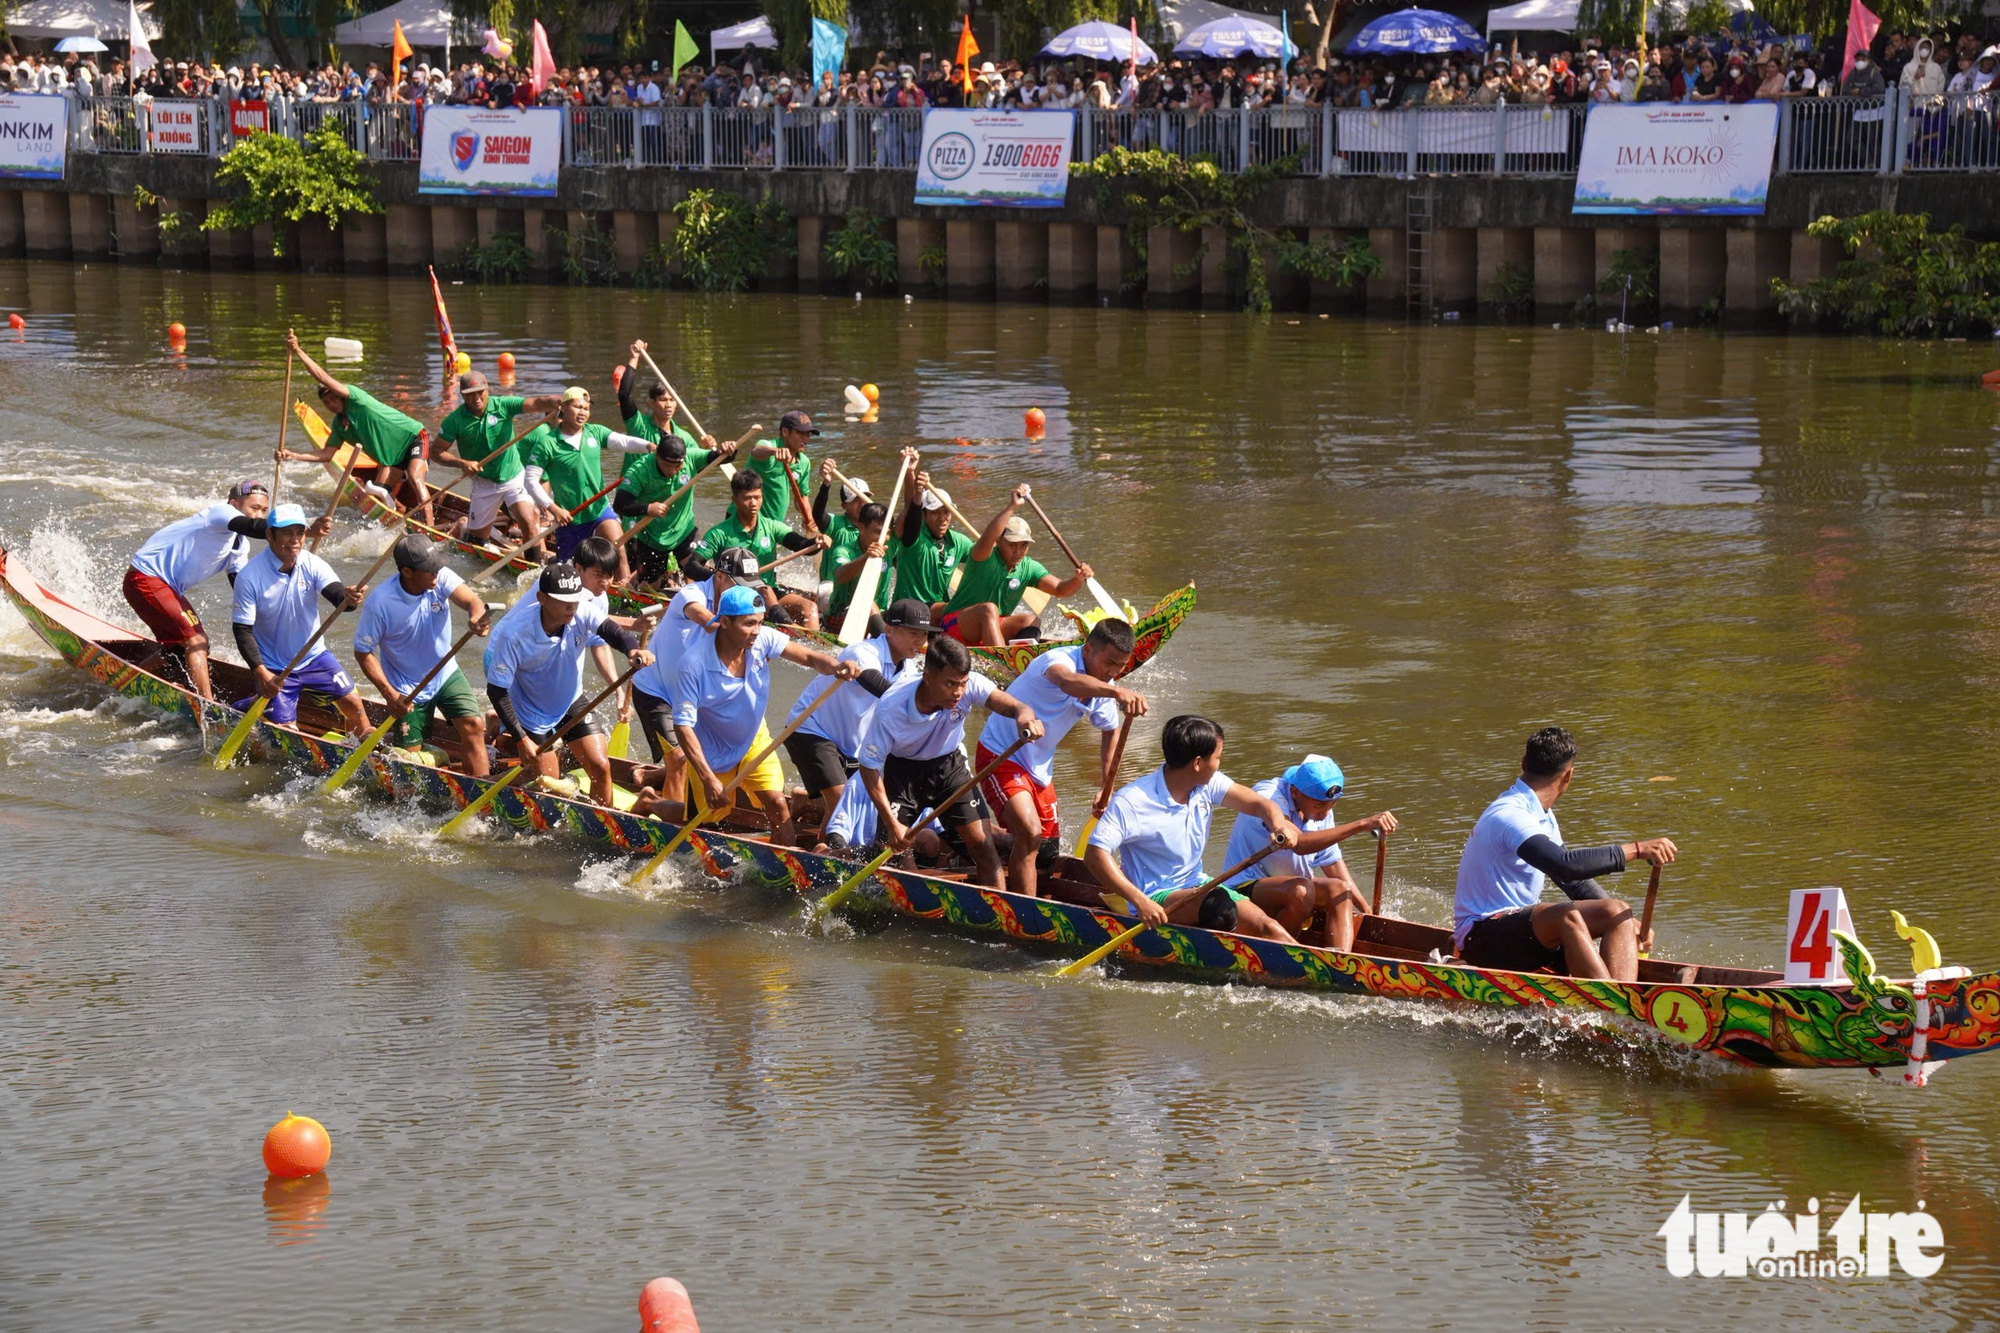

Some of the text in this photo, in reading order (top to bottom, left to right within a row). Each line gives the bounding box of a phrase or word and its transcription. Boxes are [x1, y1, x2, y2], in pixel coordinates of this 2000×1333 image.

[157, 108, 193, 125] LỐI LÊN
[234, 110, 264, 128] 400M
[0, 121, 53, 140] NKIM
[159, 128, 193, 144] XUỐNG
[17, 142, 52, 153] LAND
[484, 135, 532, 154] SAIGON
[935, 147, 966, 165] PIZZA
[1617, 145, 1724, 165] IMA KOKO
[333, 671, 350, 688] 17
[1790, 893, 1832, 979] 4
[1665, 1002, 1688, 1034] 4
